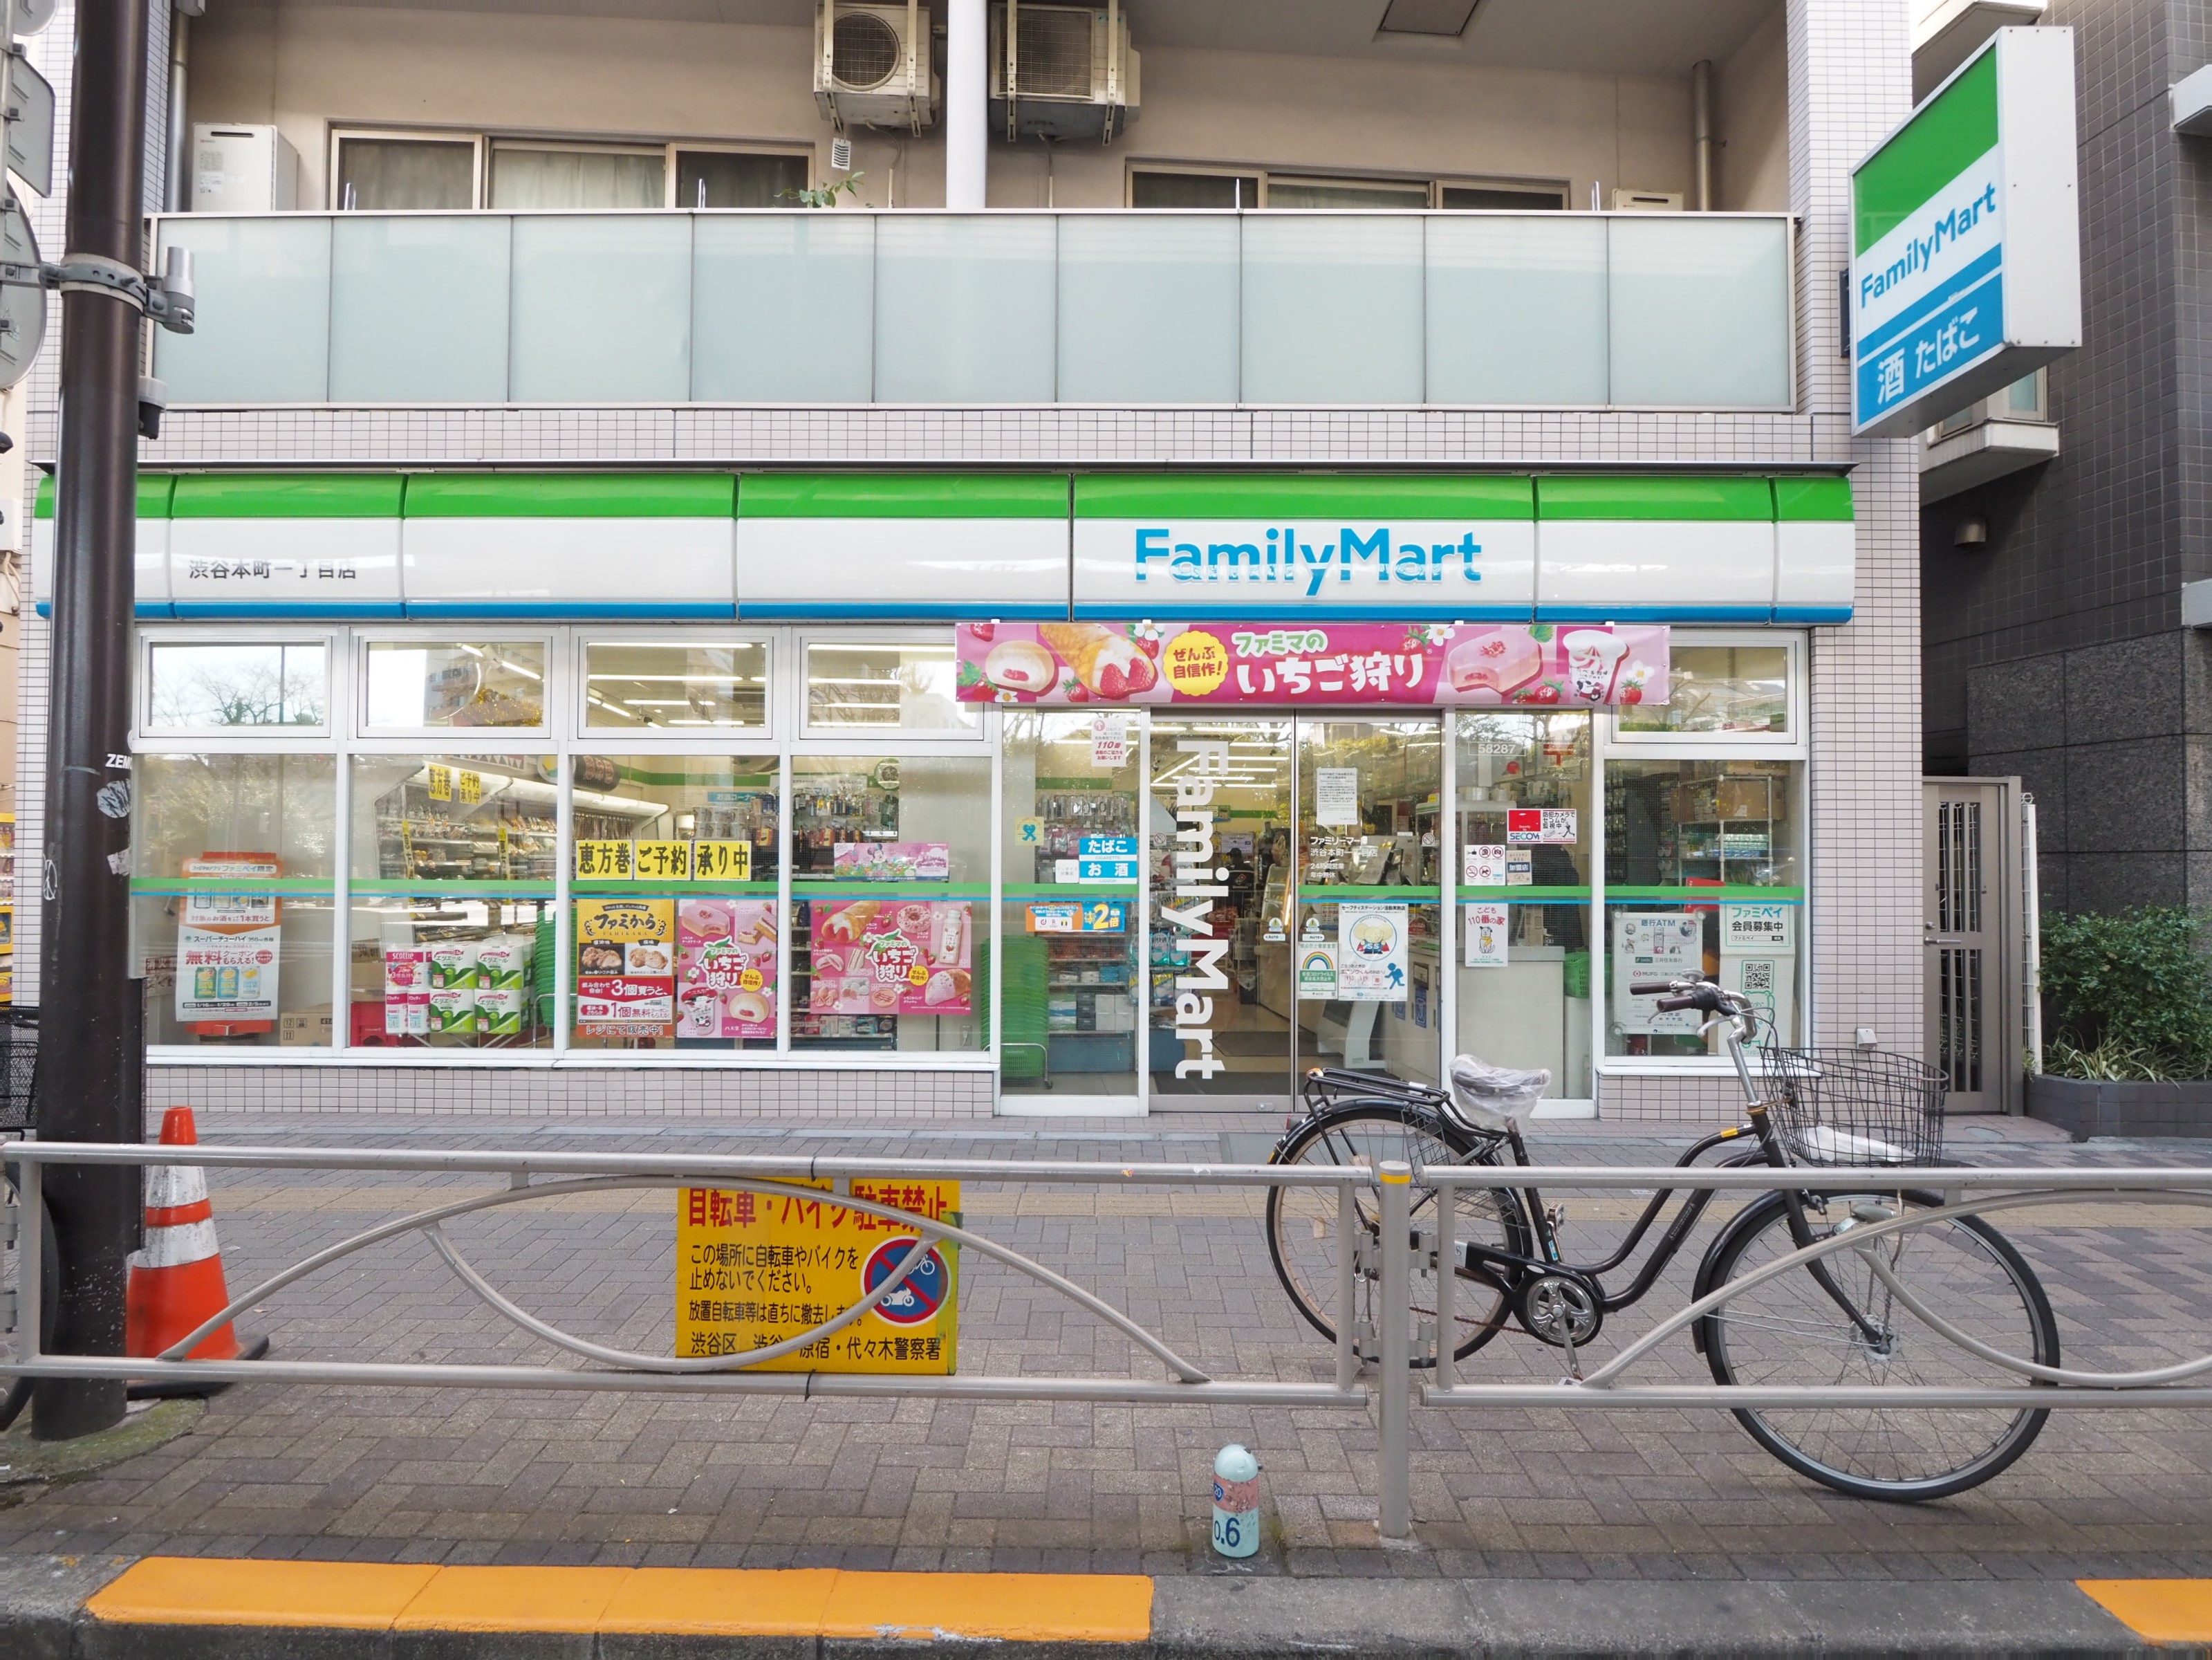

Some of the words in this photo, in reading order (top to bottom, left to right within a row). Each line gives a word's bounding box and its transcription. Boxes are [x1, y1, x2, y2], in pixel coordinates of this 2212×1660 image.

[1861, 181, 1996, 309] FamilyMart
[1877, 347, 1905, 405] 酒
[1915, 306, 1980, 379] たばこ
[189, 559, 357, 579] 渋谷本町一丁目店
[1135, 528, 1482, 596] FamilyMart
[1234, 631, 1326, 655] ファミマの
[1173, 646, 1216, 663] ぜんぶ
[1173, 661, 1222, 679] 自信作!
[1236, 651, 1423, 694] いちご狩り
[1097, 741, 1122, 749] 110番
[1478, 744, 1516, 754] 58287
[1088, 839, 1128, 854] たばこ
[1310, 848, 1378, 857] 渋谷本町一丁目店
[578, 842, 631, 875] 恵方巻
[638, 845, 687, 875] ご予約
[696, 844, 749, 876] 承り中
[1088, 863, 1128, 876] お酒
[1162, 741, 1229, 1080] FamilyMart
[1731, 907, 1783, 919] ファミペイ
[594, 913, 656, 930] ファミから
[1468, 915, 1505, 925] 110番の家
[1732, 921, 1783, 932] 会員募集中
[185, 950, 222, 964] 無料
[703, 955, 747, 970] いちご
[873, 949, 916, 963] いちご
[709, 971, 738, 987] 狩り
[878, 963, 907, 979] 狩り
[611, 979, 668, 996] 3個買うと、
[611, 1002, 651, 1017] 1個無料
[586, 1025, 664, 1035] レジにて販売中!
[691, 1244, 859, 1270] この場所に自転車やバイクを
[689, 1269, 812, 1294] 止めないでください。
[691, 1331, 737, 1355] 渋谷区
[754, 1334, 941, 1361] 渋谷原宿・代々木警察署
[1214, 1517, 1240, 1548] 0.6
